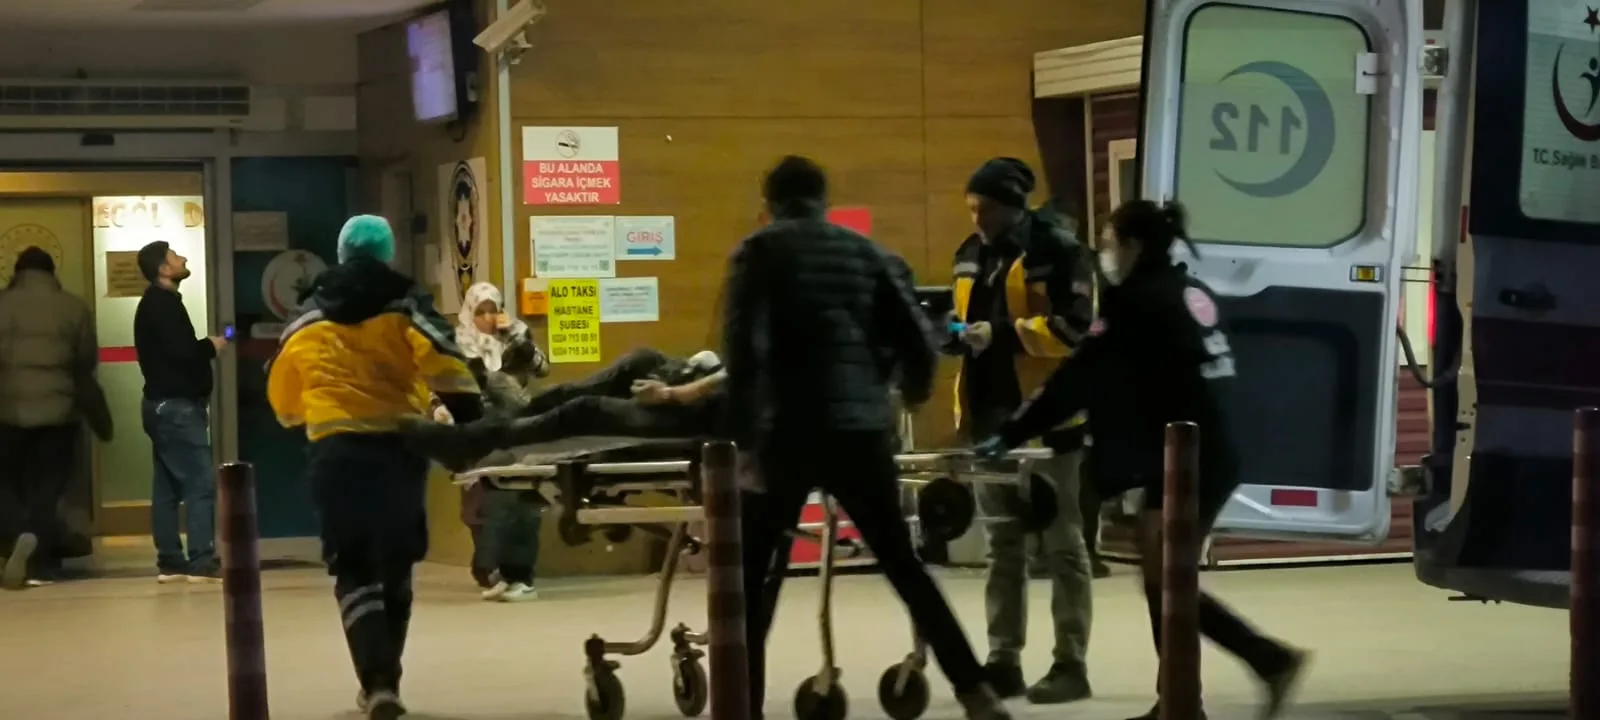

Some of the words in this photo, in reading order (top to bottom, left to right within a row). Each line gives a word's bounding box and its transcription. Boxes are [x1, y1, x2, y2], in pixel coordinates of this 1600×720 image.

[539, 163, 555, 173] BU
[558, 163, 604, 174] ALANDA
[532, 177, 573, 188] SİGARA
[576, 177, 611, 190] İÇMEK
[545, 192, 599, 202] YASAKTIR
[551, 286, 568, 297] ALO
[554, 305, 593, 315] HASTANE
